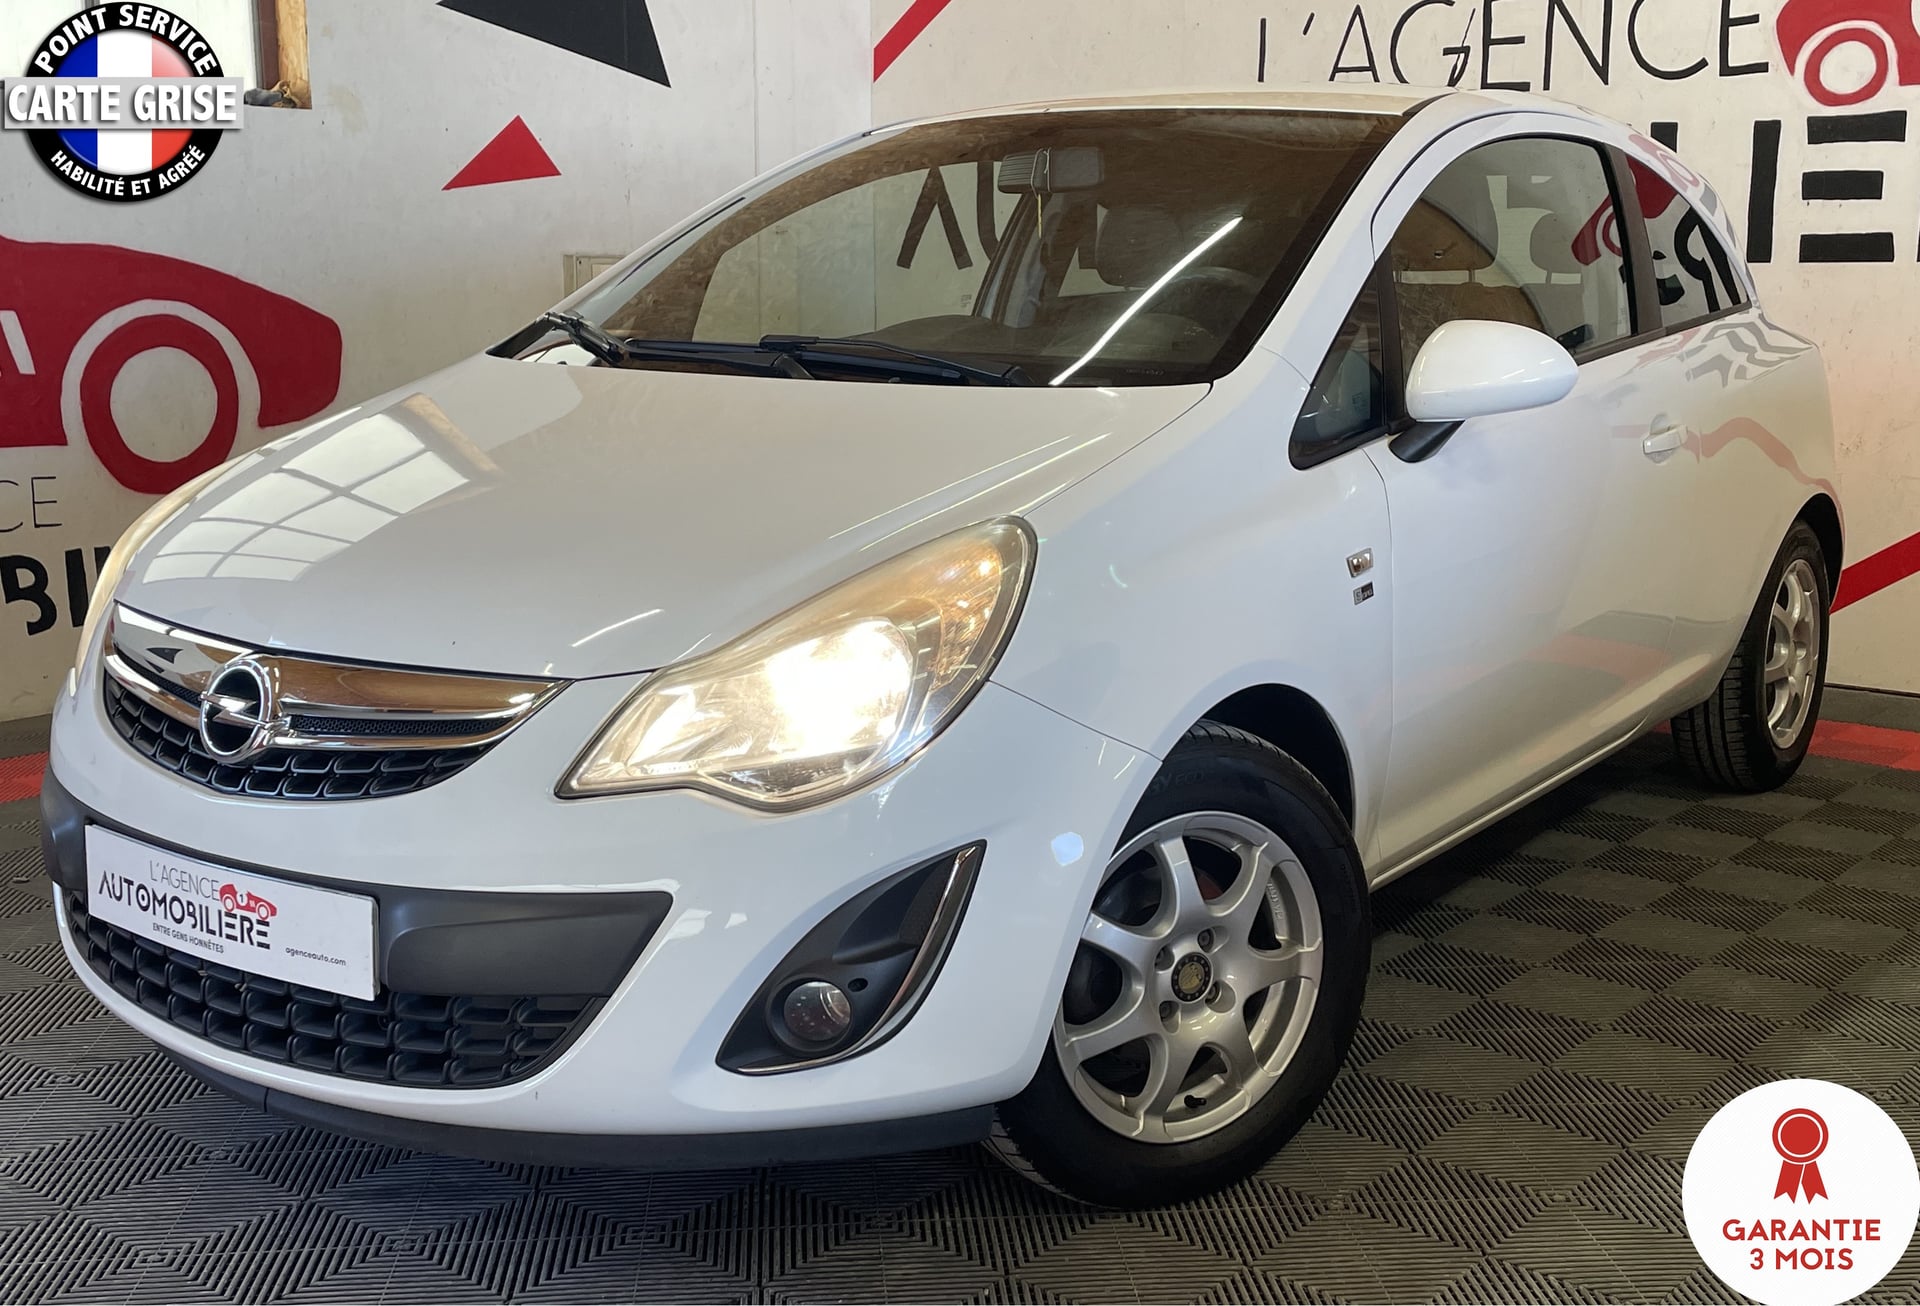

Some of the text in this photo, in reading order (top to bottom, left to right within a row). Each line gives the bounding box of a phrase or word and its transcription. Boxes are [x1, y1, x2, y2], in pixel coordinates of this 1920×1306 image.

[149, 860, 220, 902] L'AGENCE
[98, 870, 271, 950] AUTOMOBILIERE
[152, 922, 225, 954] ENTRE GENS HONNÊTES
[285, 946, 347, 967] agenceauto.com
